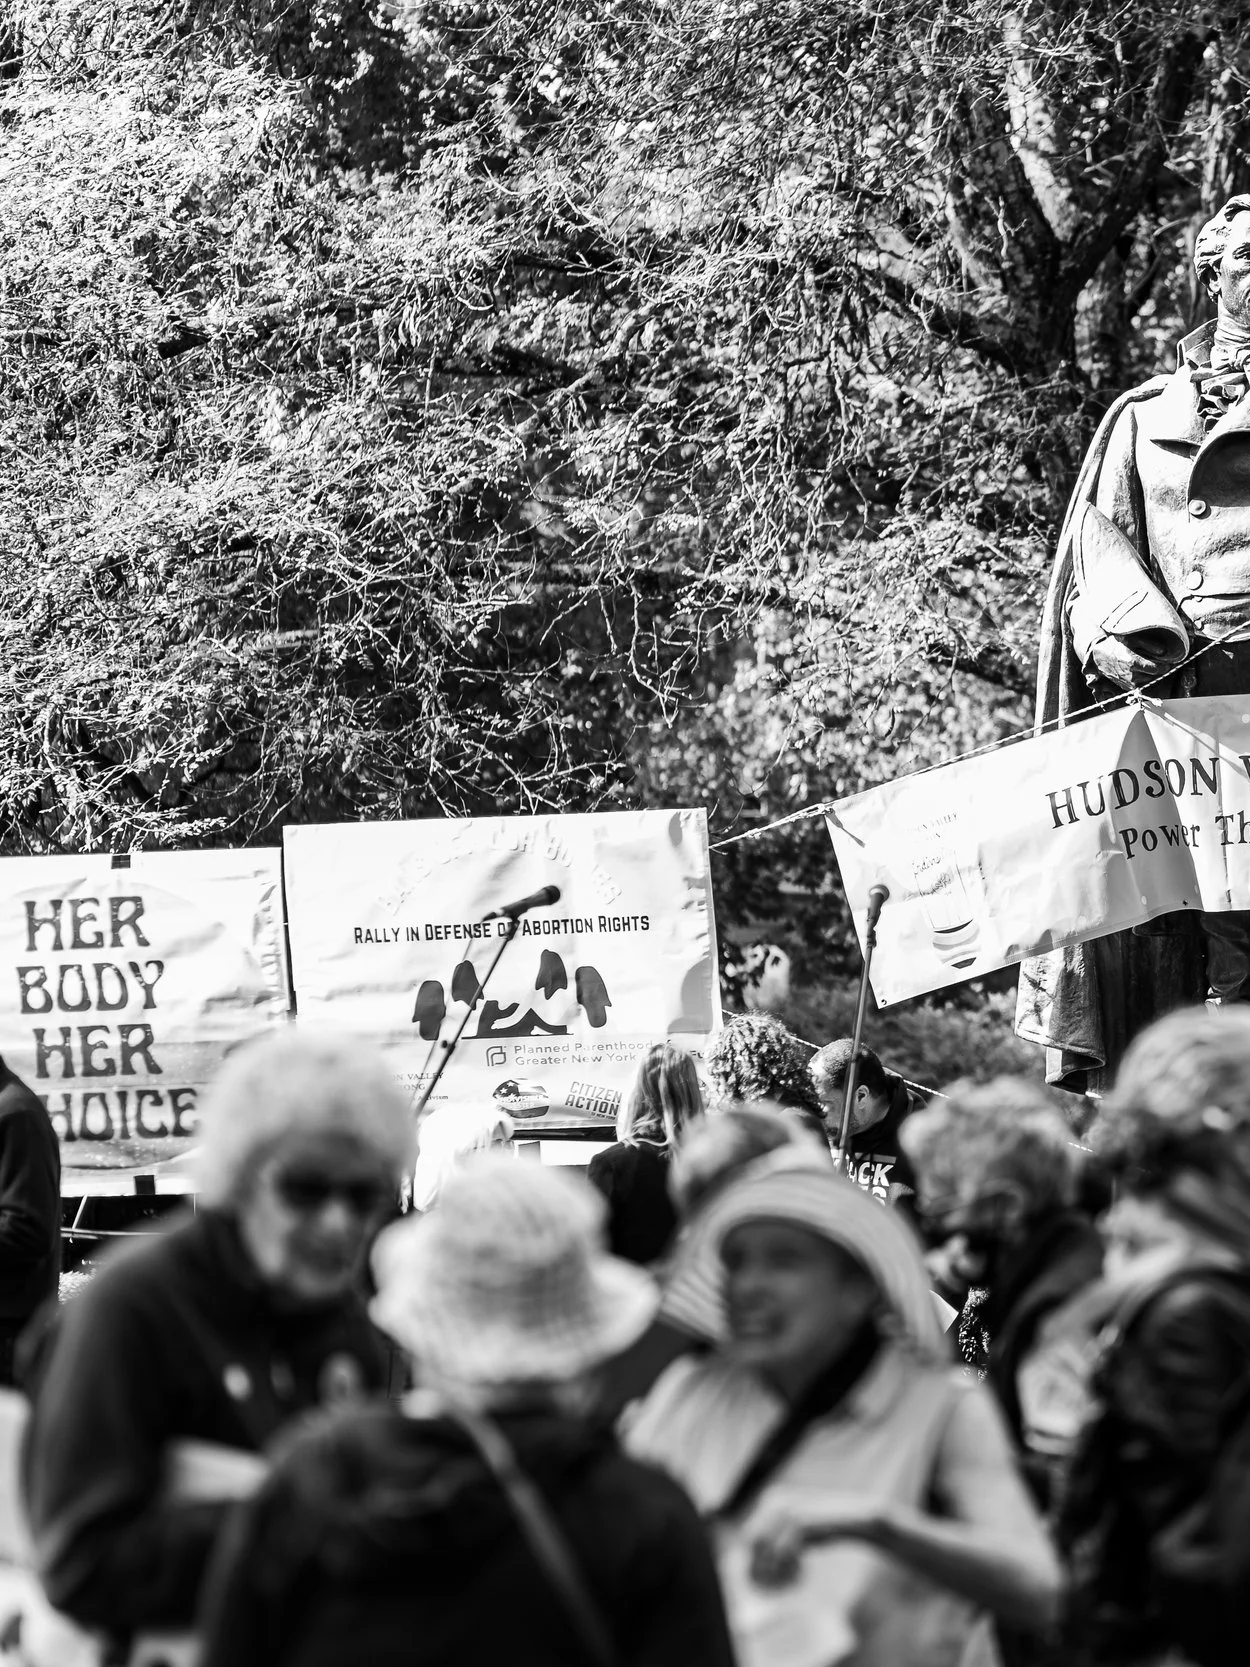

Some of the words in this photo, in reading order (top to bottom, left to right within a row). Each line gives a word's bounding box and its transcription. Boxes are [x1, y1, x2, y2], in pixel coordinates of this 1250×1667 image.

[1045, 757, 1219, 829] HUDSON
[1119, 823, 1200, 860] Power
[24, 896, 151, 951] HER
[354, 927, 400, 943] RALLY
[522, 918, 594, 936] ABORTION
[598, 915, 650, 932] RIGHTS
[16, 960, 164, 1014] BODY
[33, 1023, 163, 1078] HER
[514, 1043, 569, 1054] Planned
[515, 1056, 566, 1066] Greater
[572, 1054, 602, 1063] New
[607, 1052, 637, 1062] York
[565, 1094, 619, 1116] ACTION
[570, 1081, 622, 1103] CITIZEN
[36, 1088, 198, 1142] HOICE
